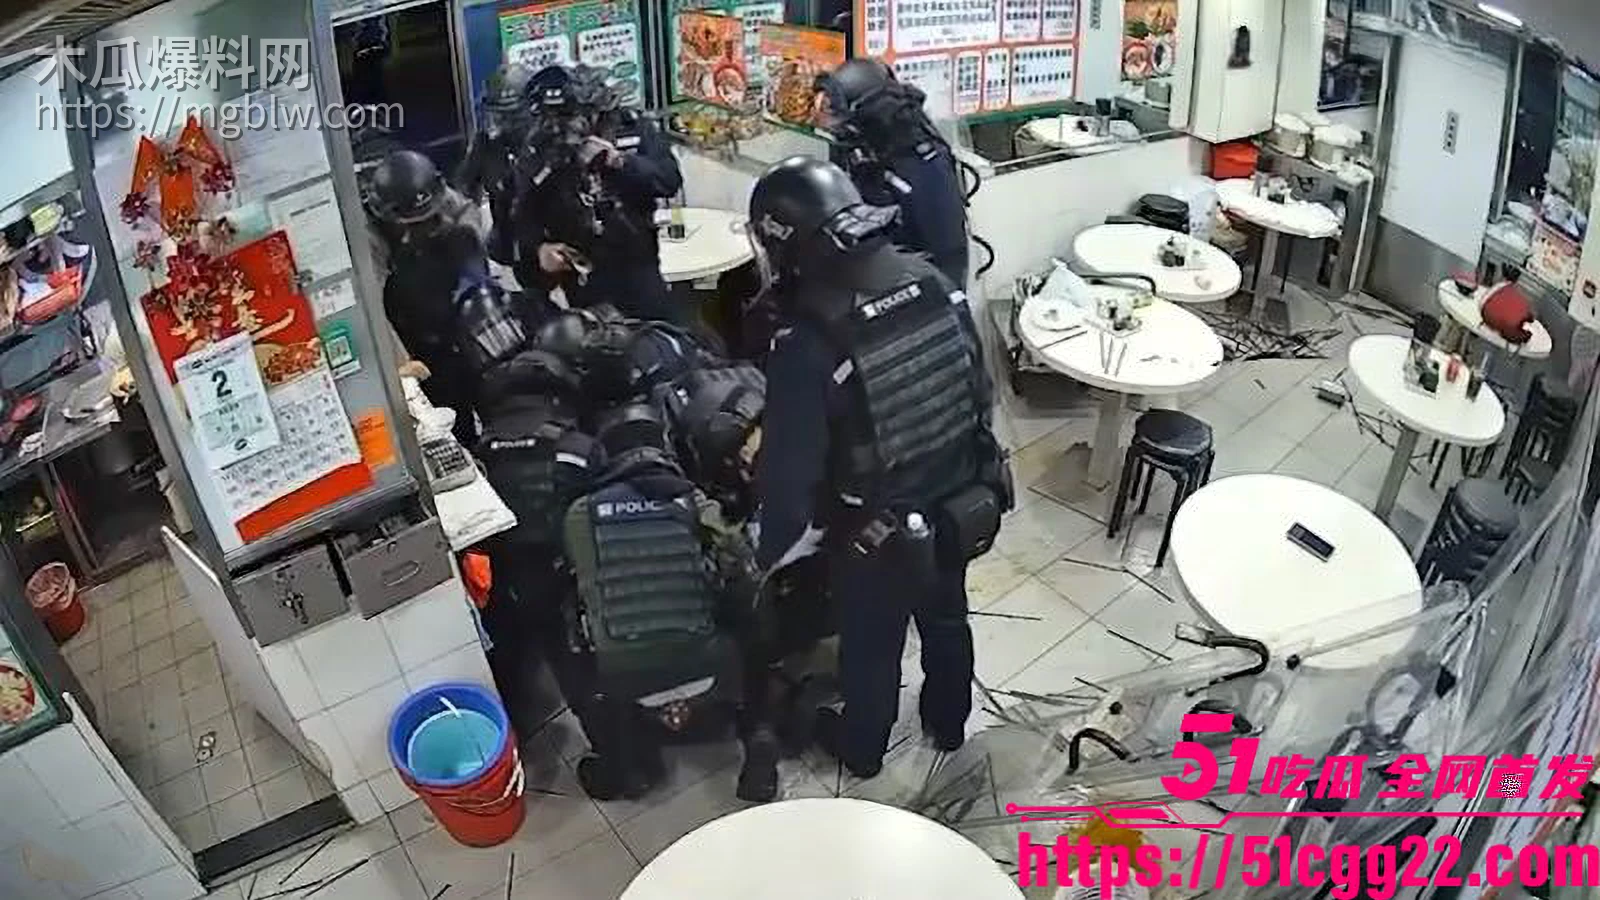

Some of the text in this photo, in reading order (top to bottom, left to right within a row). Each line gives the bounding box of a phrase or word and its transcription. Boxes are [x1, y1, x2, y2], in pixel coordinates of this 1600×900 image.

[875, 288, 912, 316] POLICE
[211, 370, 233, 398] 2
[615, 499, 672, 513] POLIC
